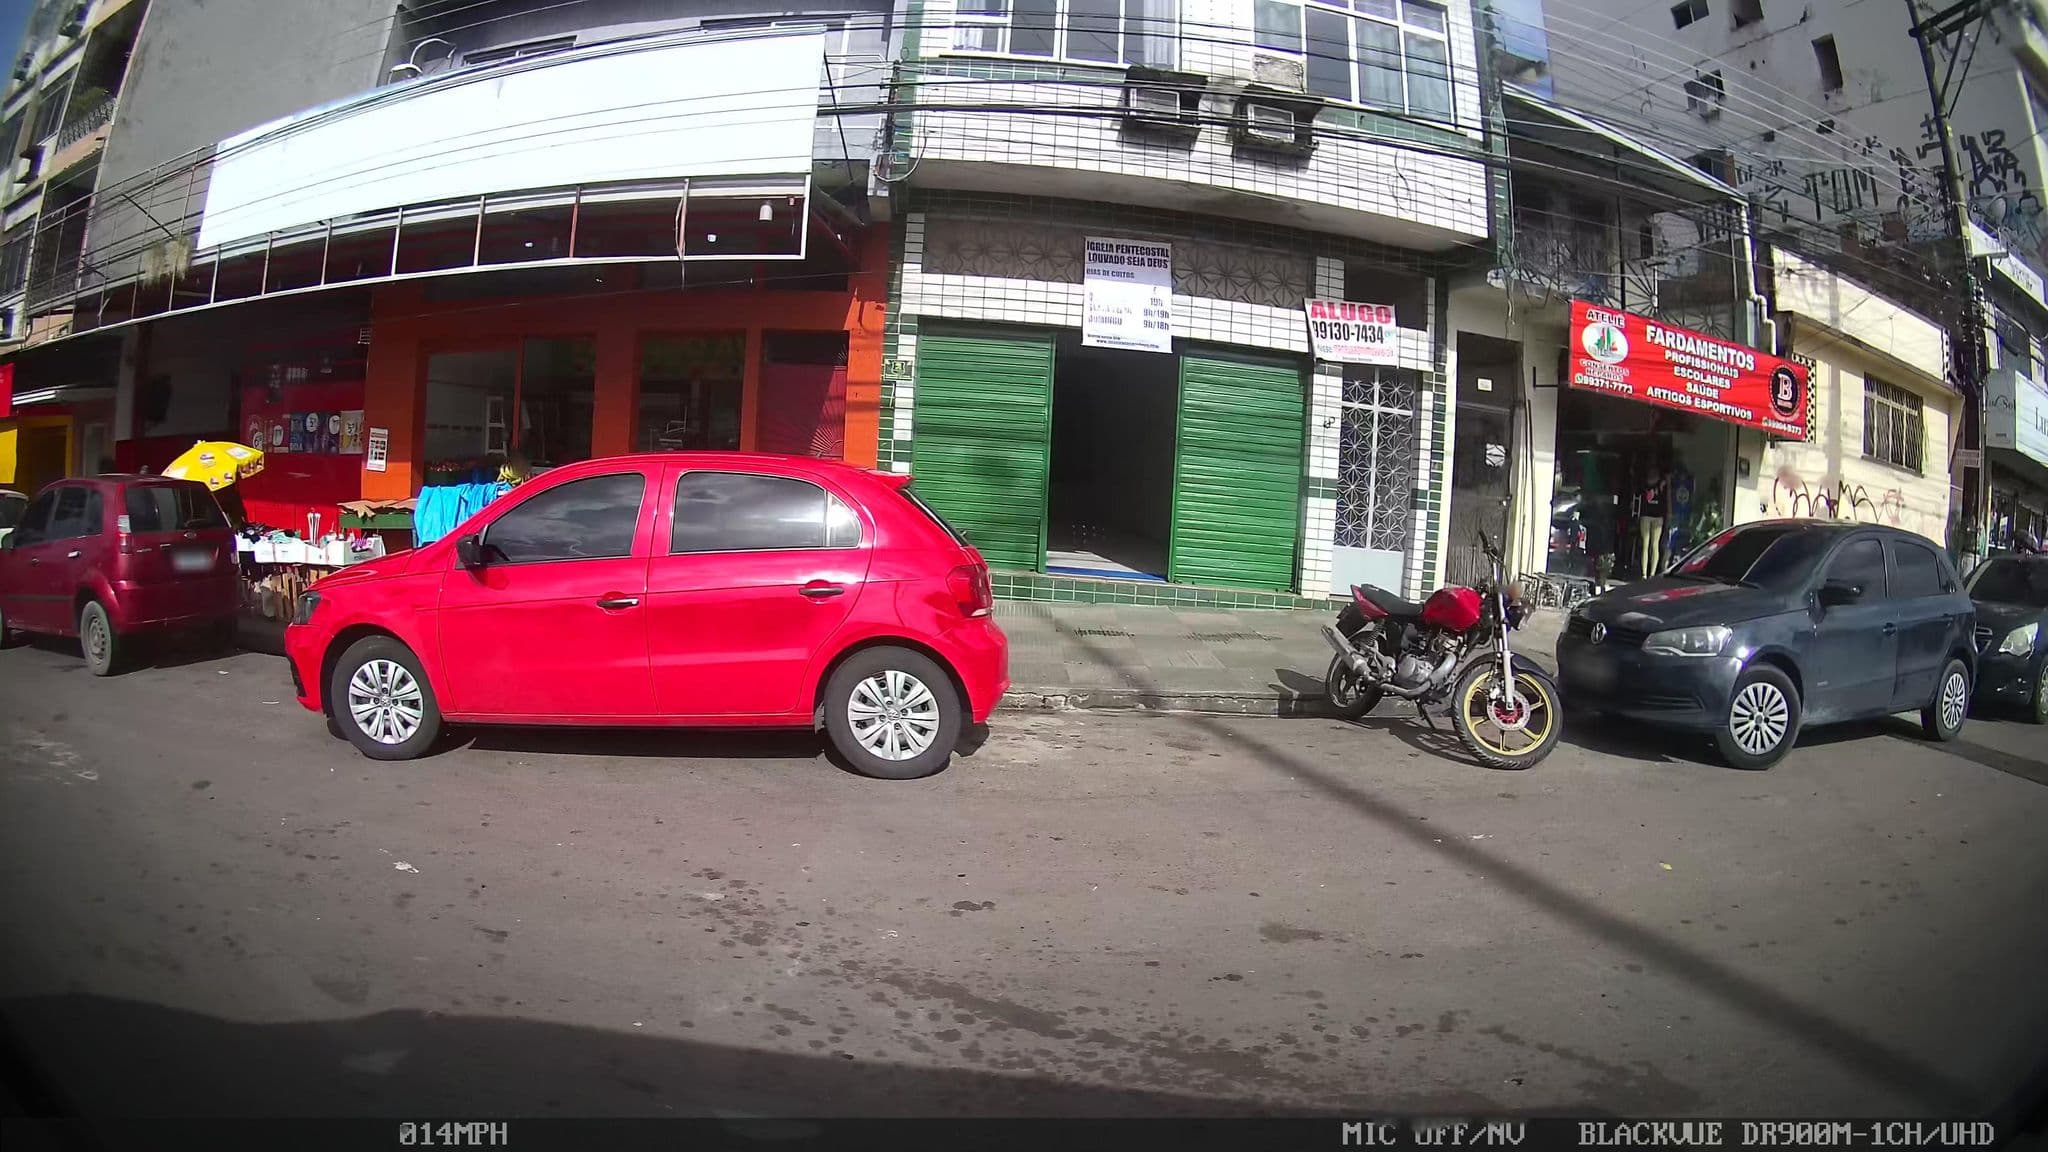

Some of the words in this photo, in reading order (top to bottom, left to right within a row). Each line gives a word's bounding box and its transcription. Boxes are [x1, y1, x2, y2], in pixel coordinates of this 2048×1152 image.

[1086, 241, 1114, 253] IGREJA
[1115, 243, 1170, 258] PENTECOSTAL
[1088, 252, 1126, 265] LOUVADO
[1126, 256, 1146, 267] SEJA
[1147, 258, 1169, 269] DEUS
[1311, 300, 1392, 325] ALUGO
[1646, 325, 1755, 371] FARDAMENTOS
[1665, 351, 1740, 379] PROFISSIONAIS
[1674, 366, 1731, 389] ESCOLARES
[1686, 382, 1720, 399] SAÚDE
[1777, 373, 1793, 401] B
[1647, 386, 1692, 406] ARTIGOS
[1694, 398, 1753, 420] ESPORTIVOS
